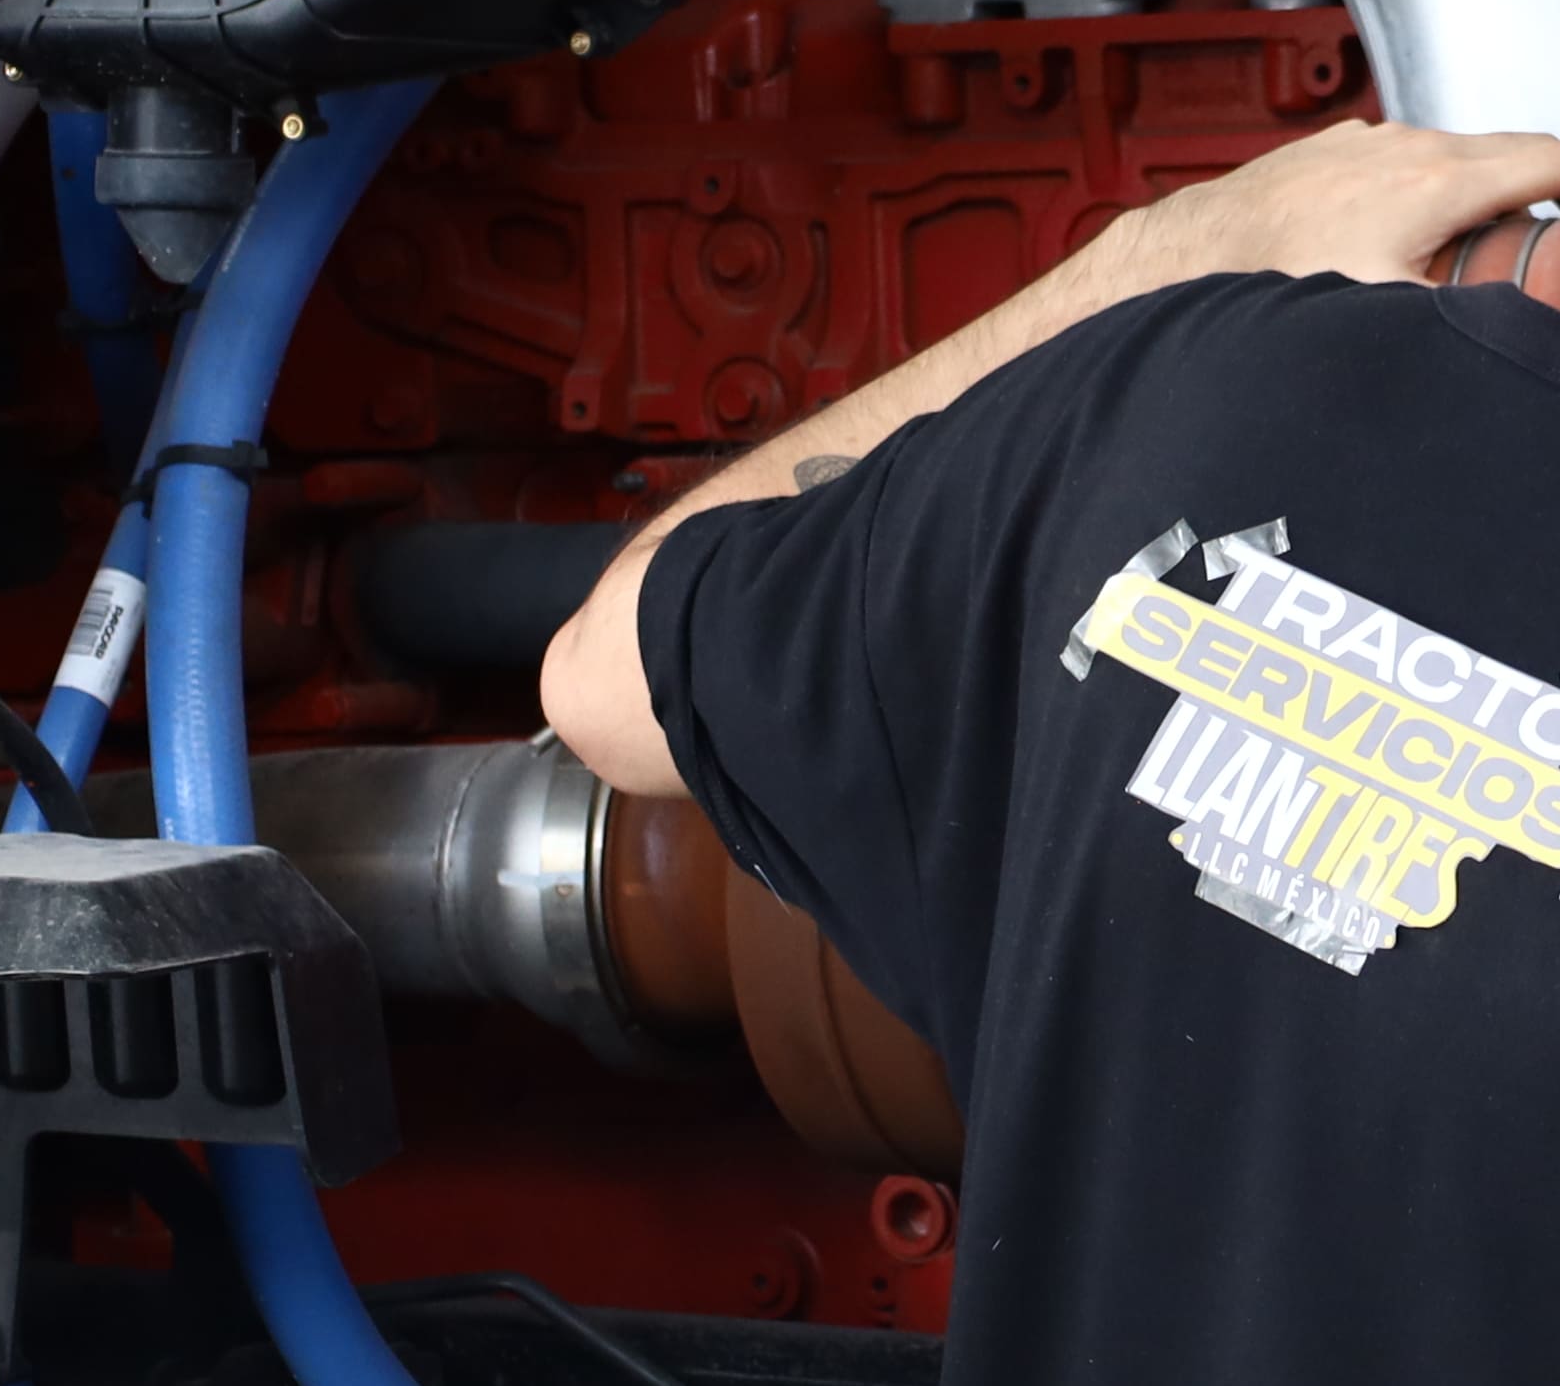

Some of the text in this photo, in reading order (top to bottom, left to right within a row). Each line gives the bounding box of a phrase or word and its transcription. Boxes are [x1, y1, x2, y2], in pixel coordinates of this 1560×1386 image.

[93, 604, 124, 660] PACCAR
[1186, 831, 1382, 952] LLC MÉXICO
